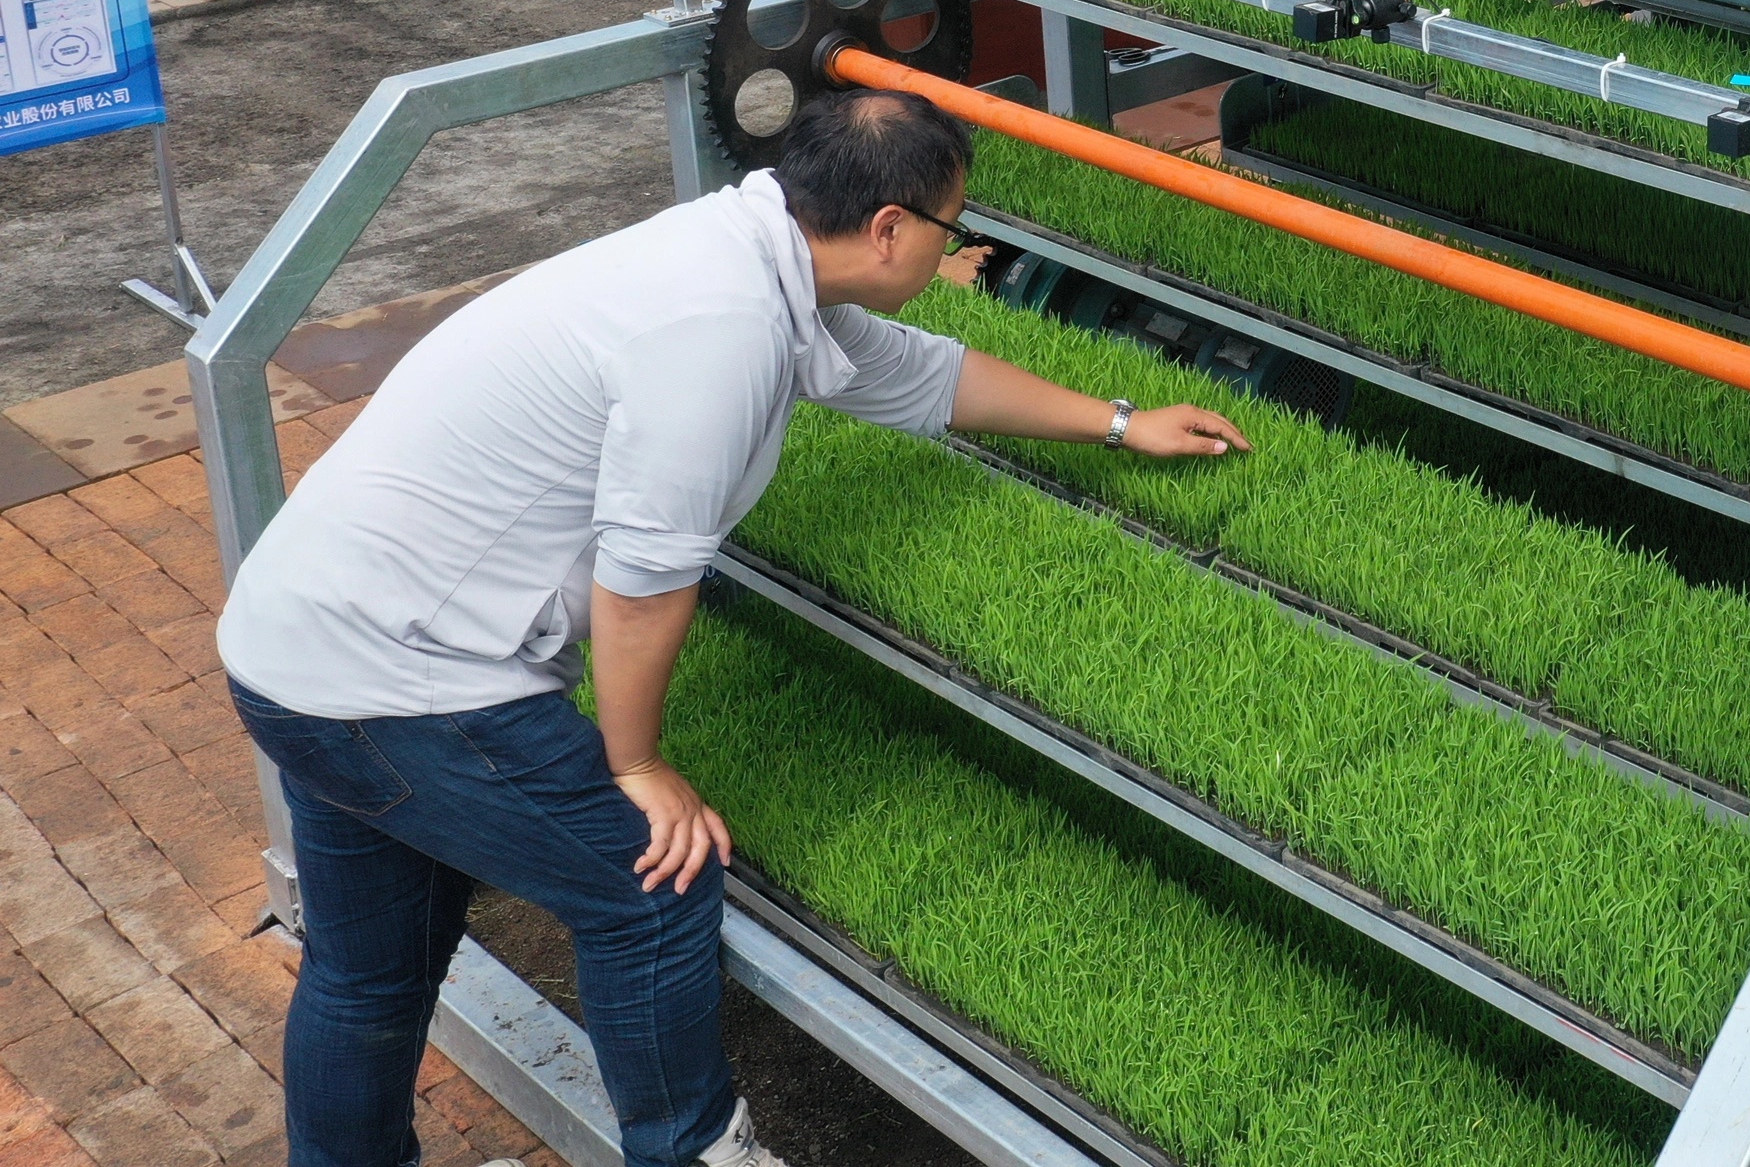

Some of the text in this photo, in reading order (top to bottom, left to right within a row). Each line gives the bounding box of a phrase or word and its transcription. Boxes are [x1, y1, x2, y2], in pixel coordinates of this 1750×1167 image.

[0, 88, 130, 129] 业股份有限公司
